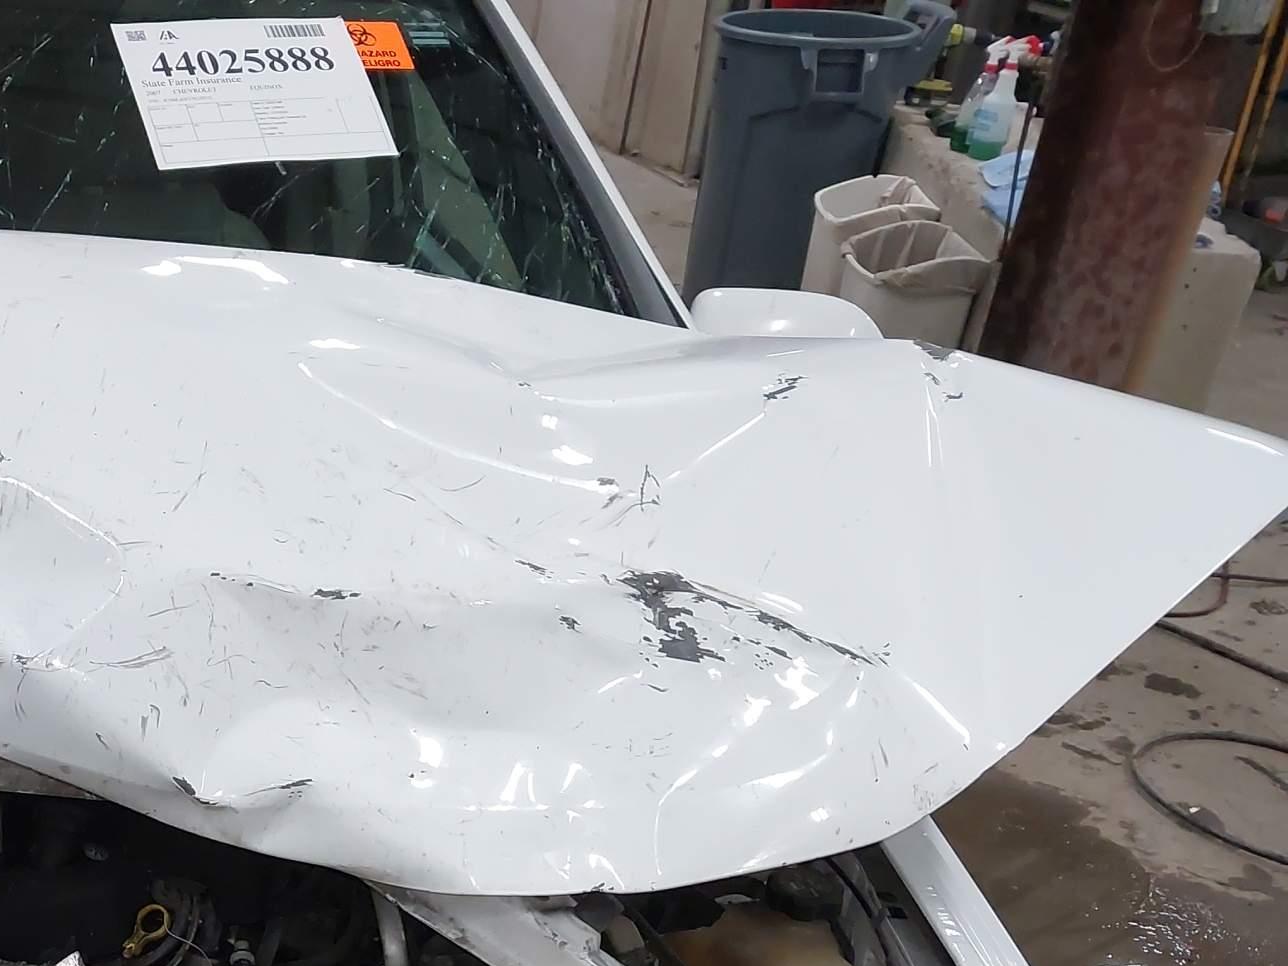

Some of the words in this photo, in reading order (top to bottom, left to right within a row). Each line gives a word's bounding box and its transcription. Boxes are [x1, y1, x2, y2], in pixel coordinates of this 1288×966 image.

[152, 46, 335, 77] 44025888
[362, 59, 400, 67] ELIGRO
[141, 79, 166, 88] State
[169, 78, 194, 87] Farm
[196, 76, 242, 85] Insurance
